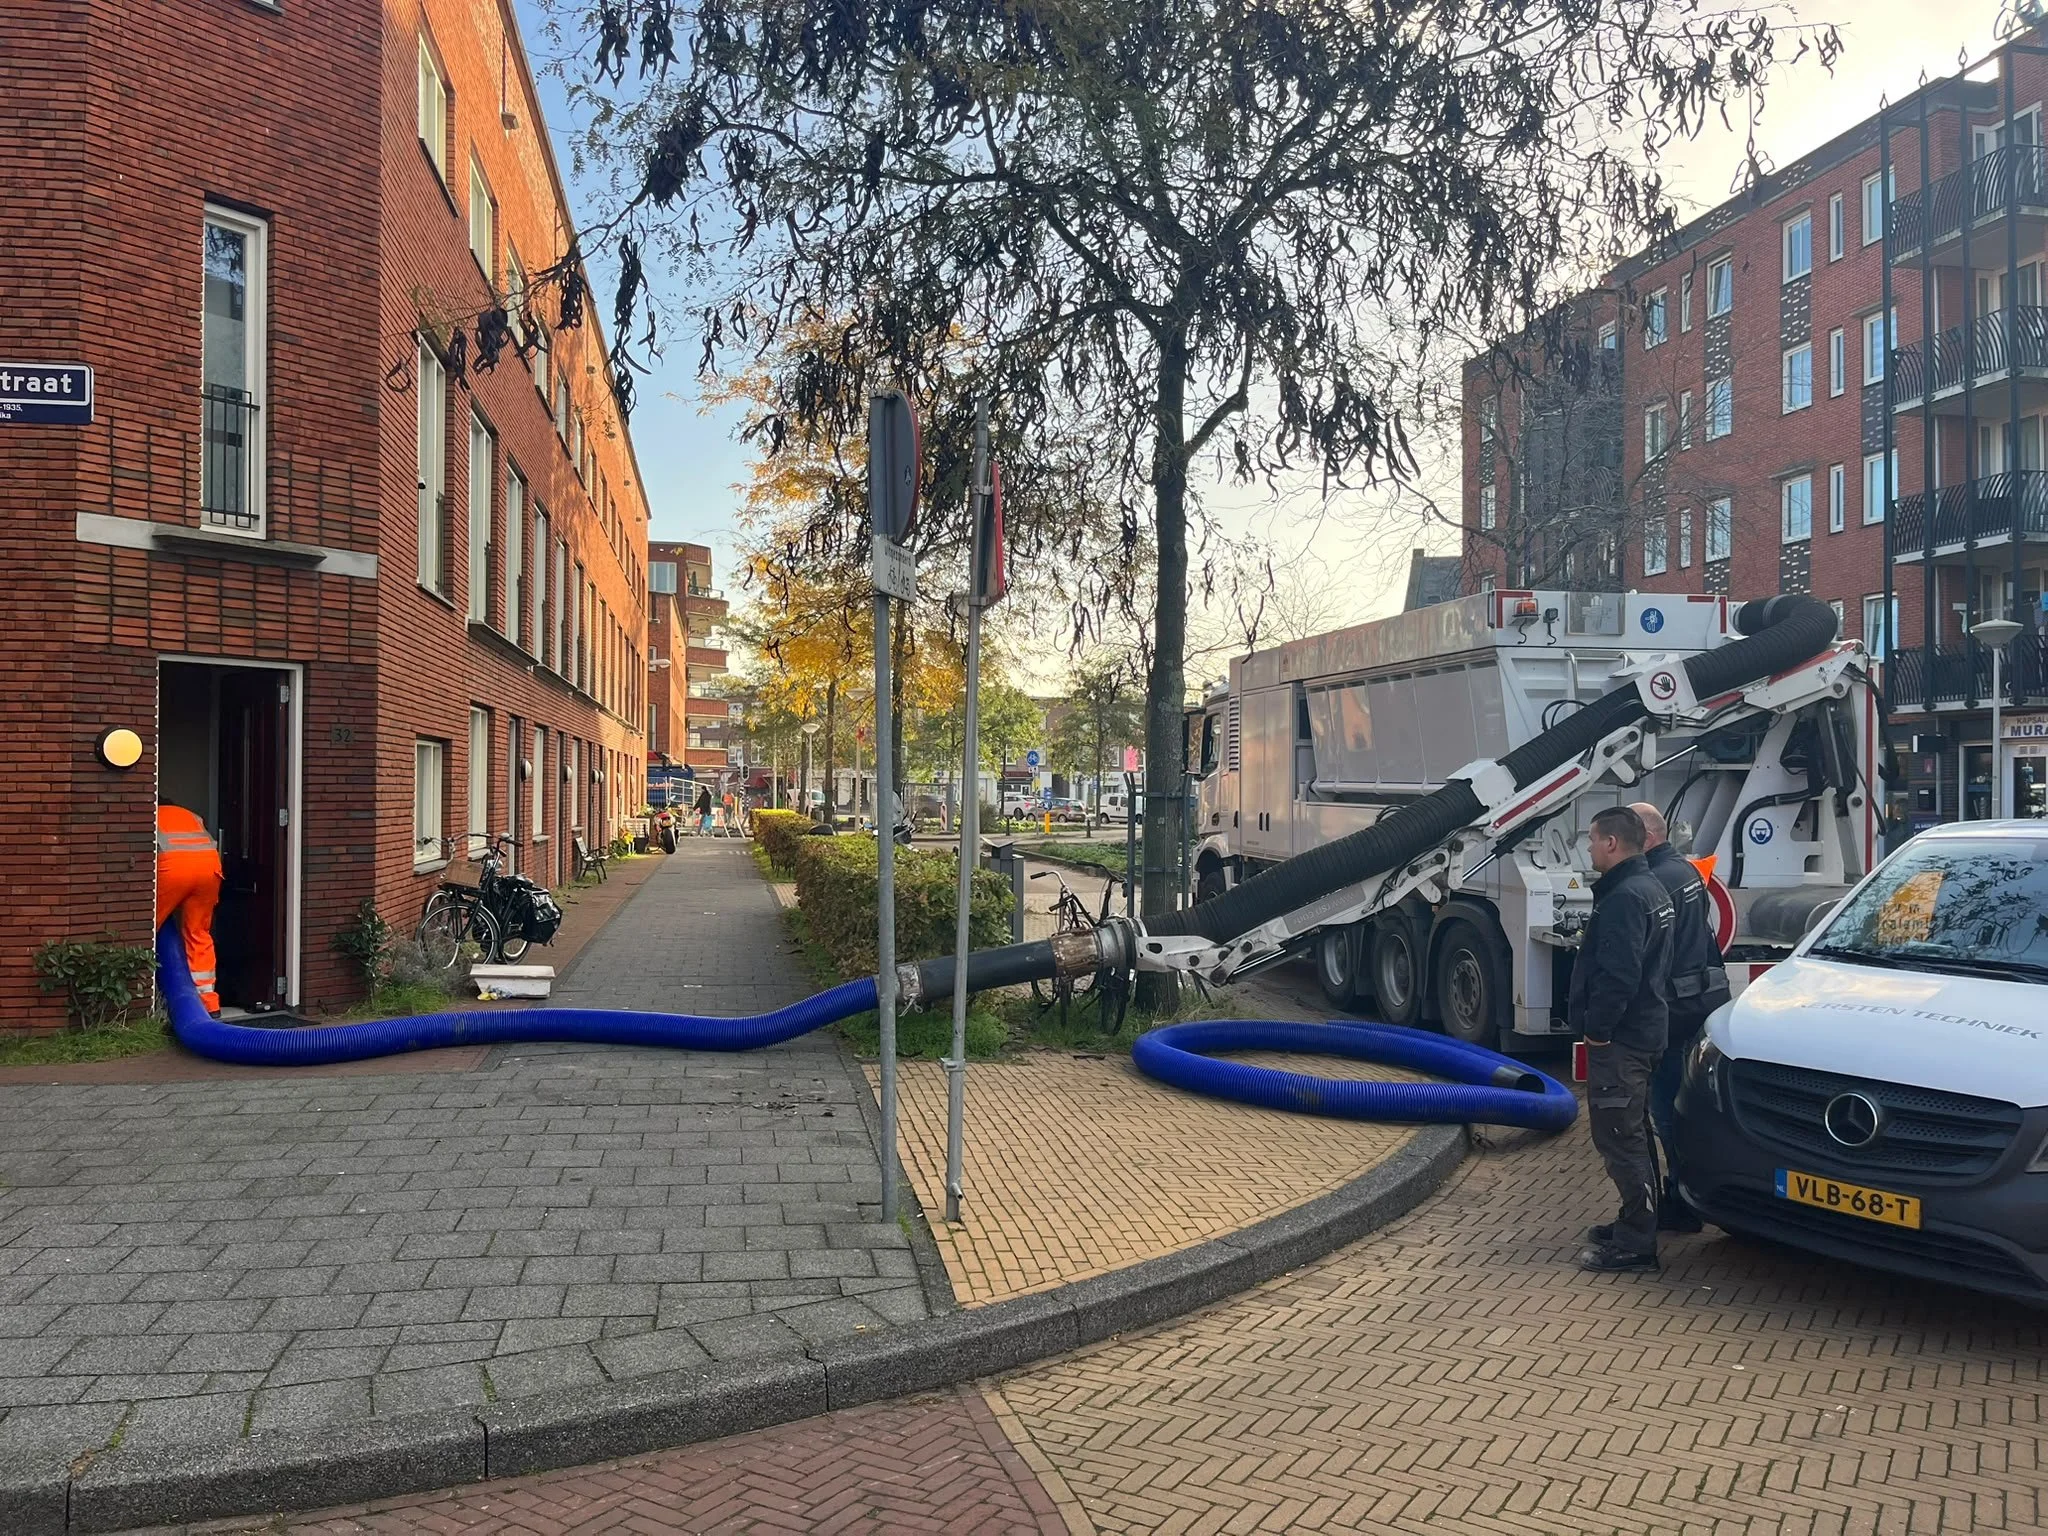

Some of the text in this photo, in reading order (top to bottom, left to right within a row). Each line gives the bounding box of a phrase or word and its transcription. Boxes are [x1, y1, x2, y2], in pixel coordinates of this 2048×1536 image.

[0, 370, 72, 394] traat
[334, 728, 351, 743] 32
[1800, 1002, 2043, 1040] ERSTEN TECHNIEK
[1776, 1184, 1786, 1194] NL
[1795, 1175, 1911, 1222] VLB-68-T
